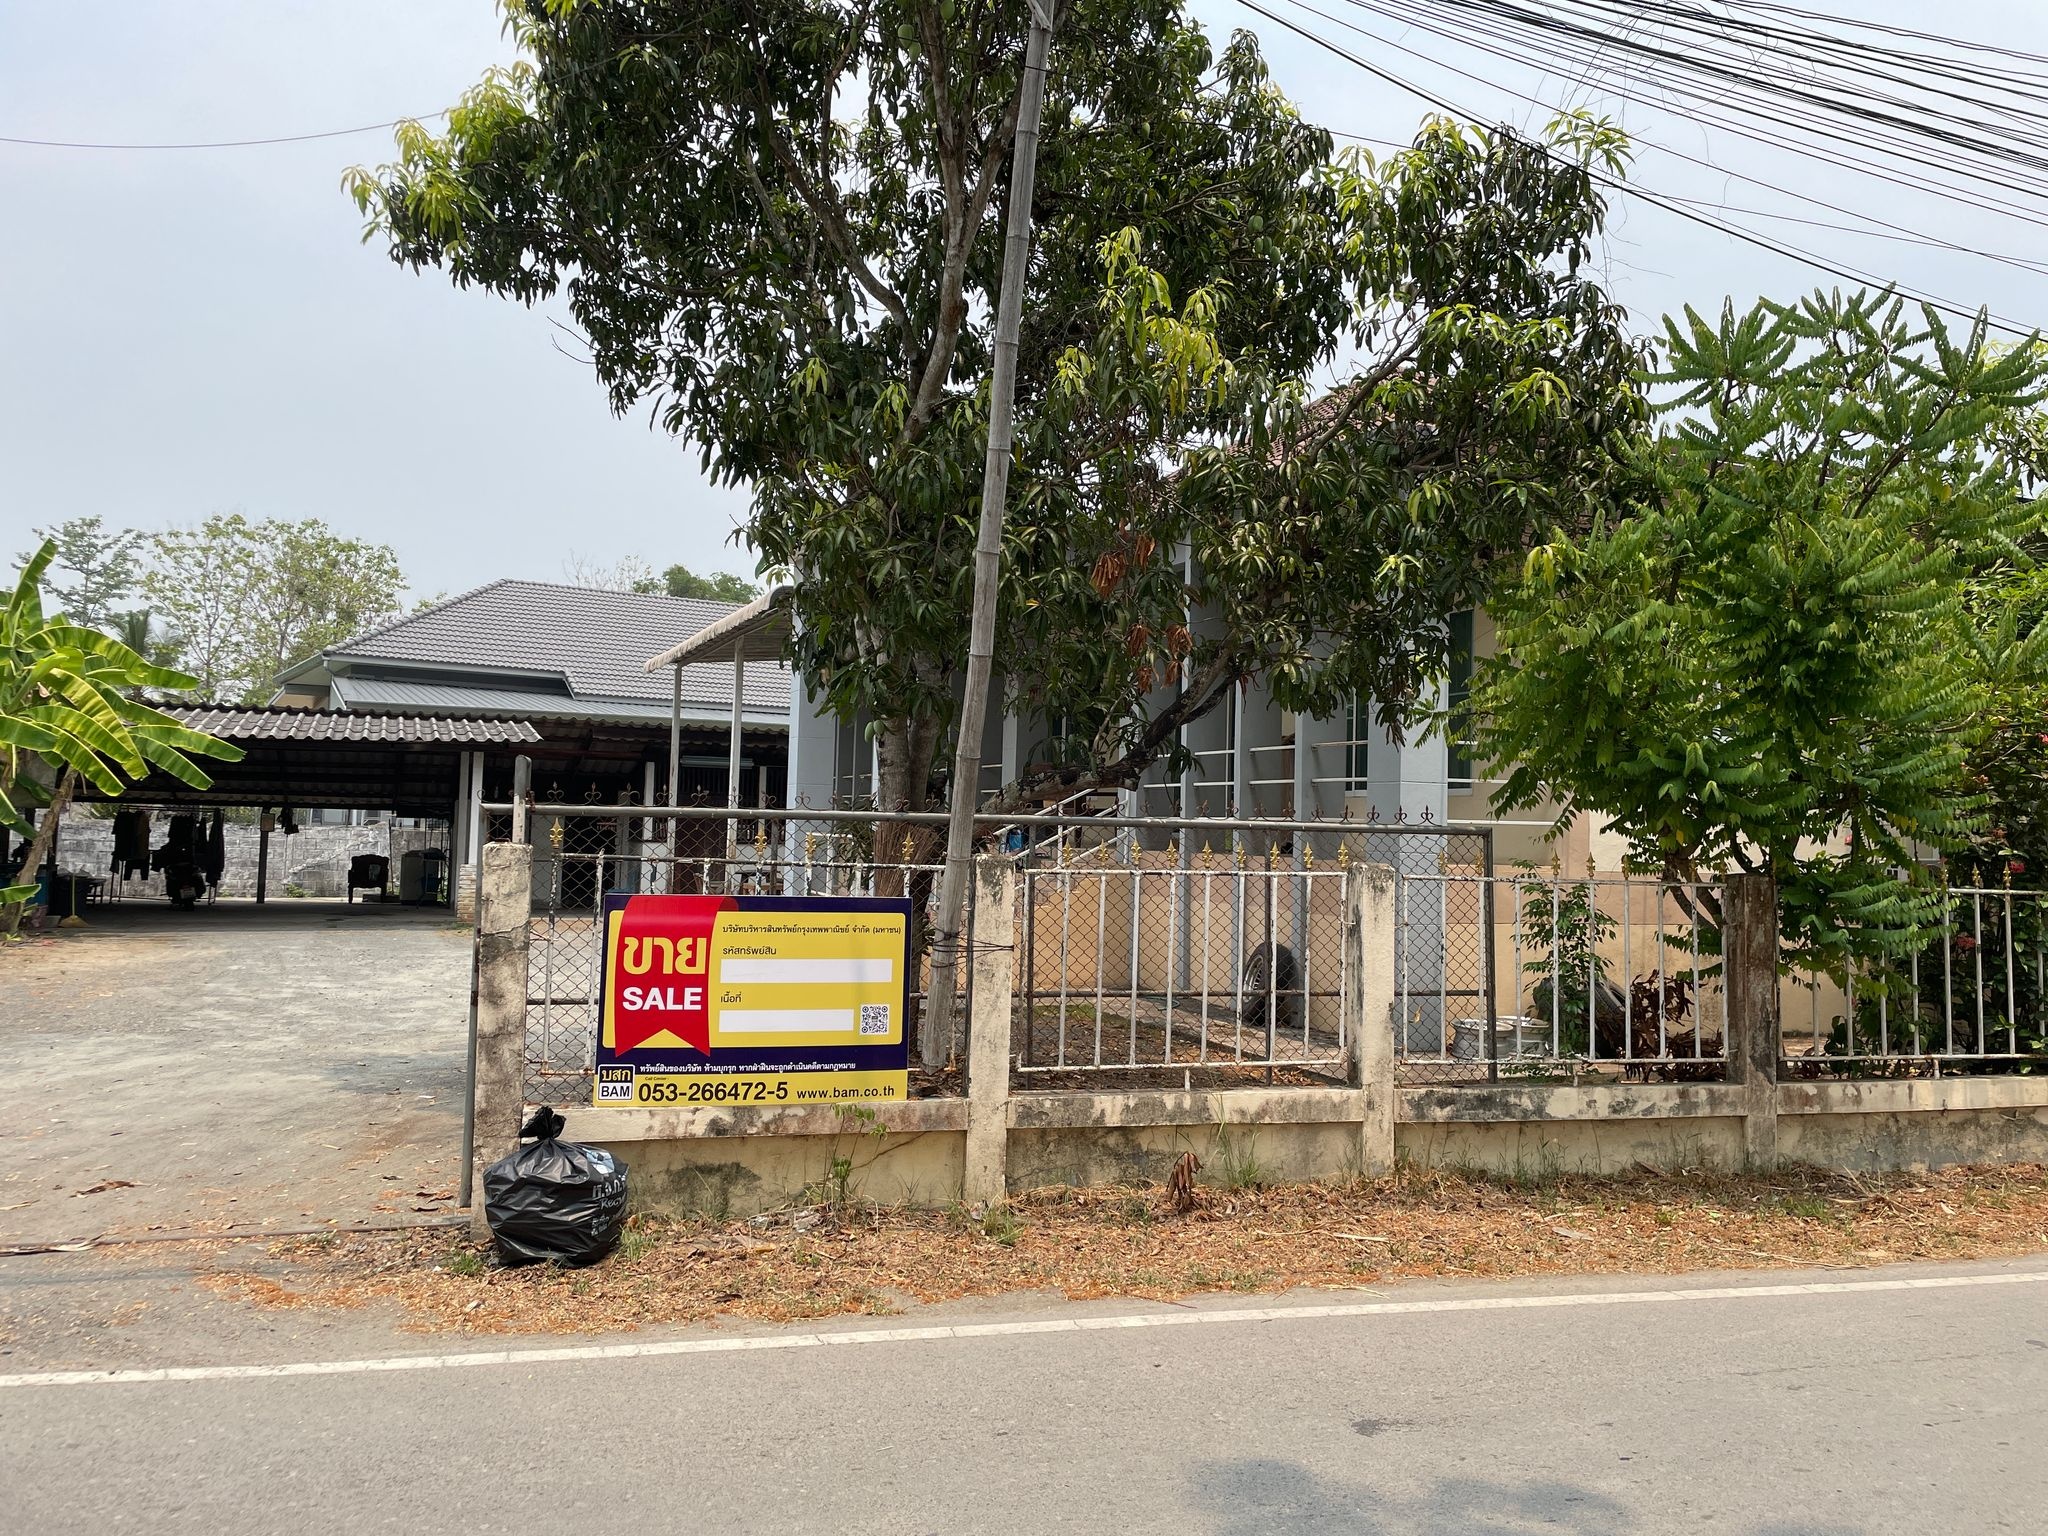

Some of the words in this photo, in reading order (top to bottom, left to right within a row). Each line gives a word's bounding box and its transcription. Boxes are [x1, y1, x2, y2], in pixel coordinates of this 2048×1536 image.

[722, 924, 850, 936] บริษัทบริหารสินทรัพย์กรุงเทพพาณิชย์
[852, 925, 870, 934] จำกัด
[873, 926, 902, 935] (มหาชน)
[623, 936, 708, 975] ขาย
[722, 945, 777, 956] รหัสทรัพย์สิน
[622, 986, 703, 1011] SALE
[720, 992, 742, 1004] เนื้อที่
[639, 1063, 702, 1073] ทรัพย์สินของบริษัท
[704, 1063, 737, 1075] ห้ามบุกรุก
[601, 1069, 631, 1082] บสก
[600, 1086, 630, 1098] BAM
[638, 1081, 789, 1102] 053-266472-5
[797, 1086, 895, 1099] www.bam.co.th
